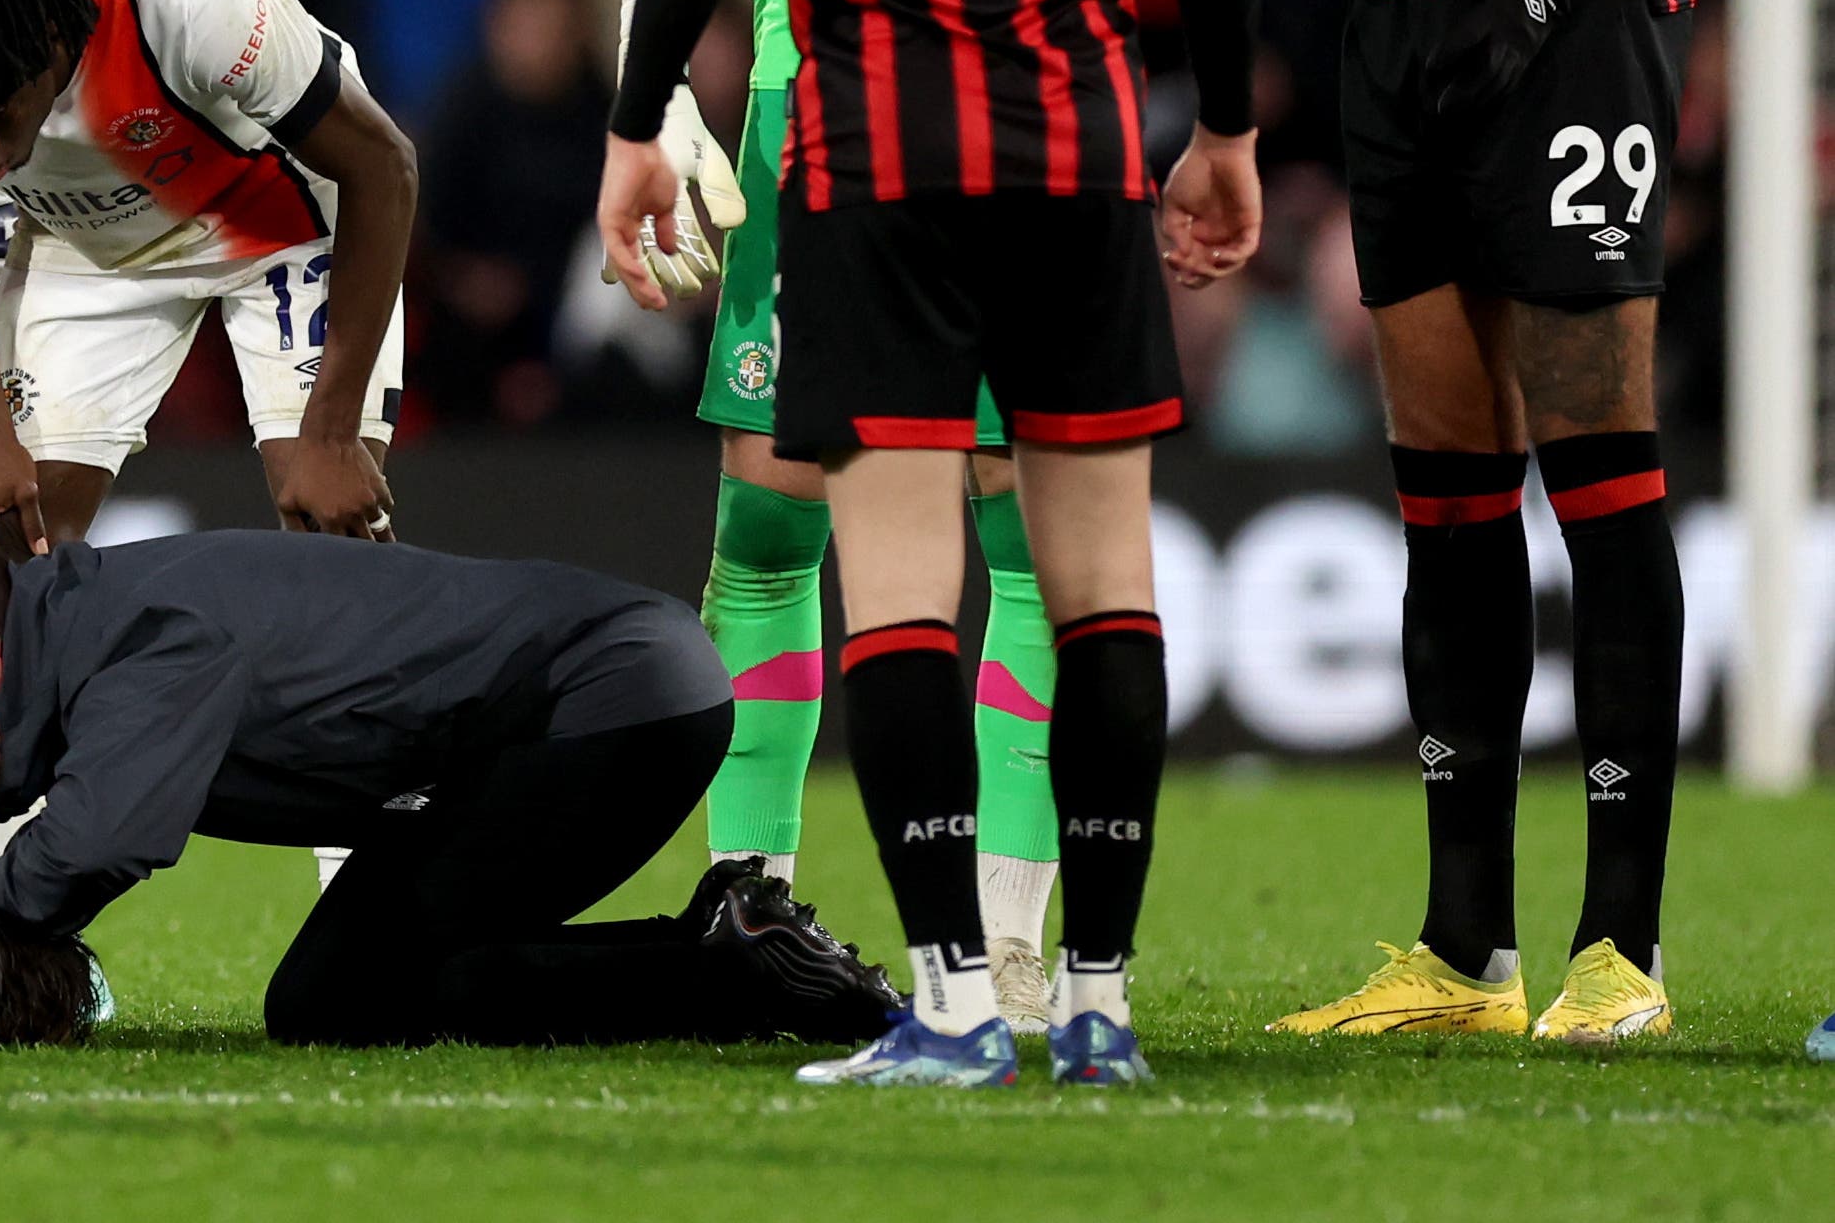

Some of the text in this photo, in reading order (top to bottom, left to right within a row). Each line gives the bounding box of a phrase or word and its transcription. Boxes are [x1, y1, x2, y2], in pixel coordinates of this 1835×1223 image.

[1548, 124, 1656, 227] 29
[1595, 248, 1625, 261] umbro
[1590, 788, 1626, 801] umbro
[1067, 817, 1141, 841] AFCB
